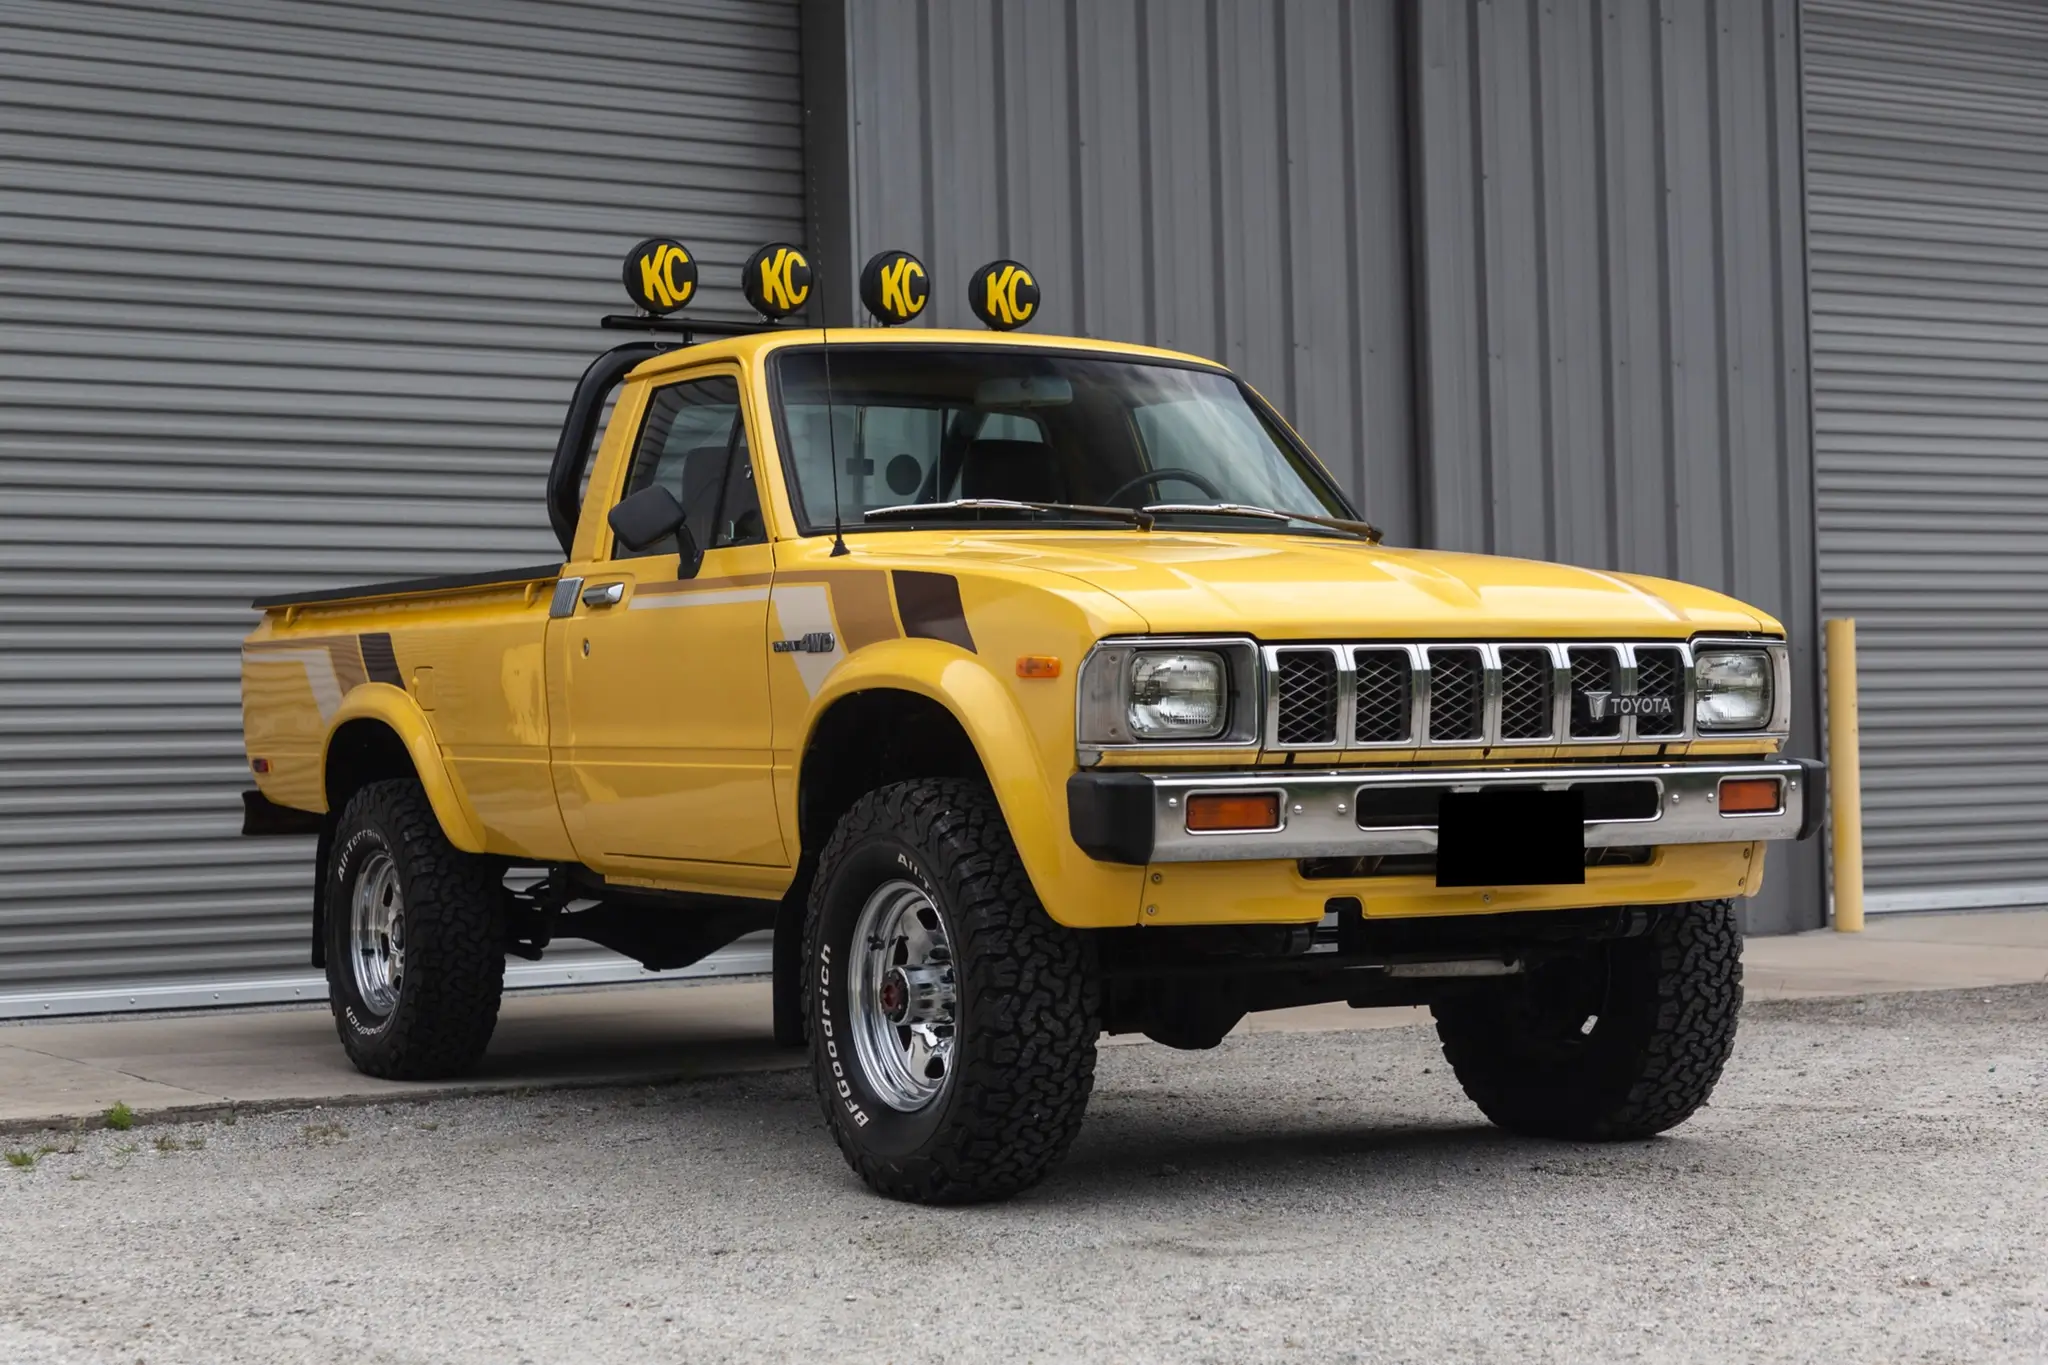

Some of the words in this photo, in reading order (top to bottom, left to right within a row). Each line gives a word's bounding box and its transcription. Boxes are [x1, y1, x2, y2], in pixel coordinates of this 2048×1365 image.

[640, 244, 692, 307] KC
[761, 247, 808, 309] KC
[880, 257, 925, 317] KC
[986, 265, 1034, 324] KC
[1611, 697, 1672, 714] TOYOTA
[820, 943, 870, 1128] BFGoodrich
